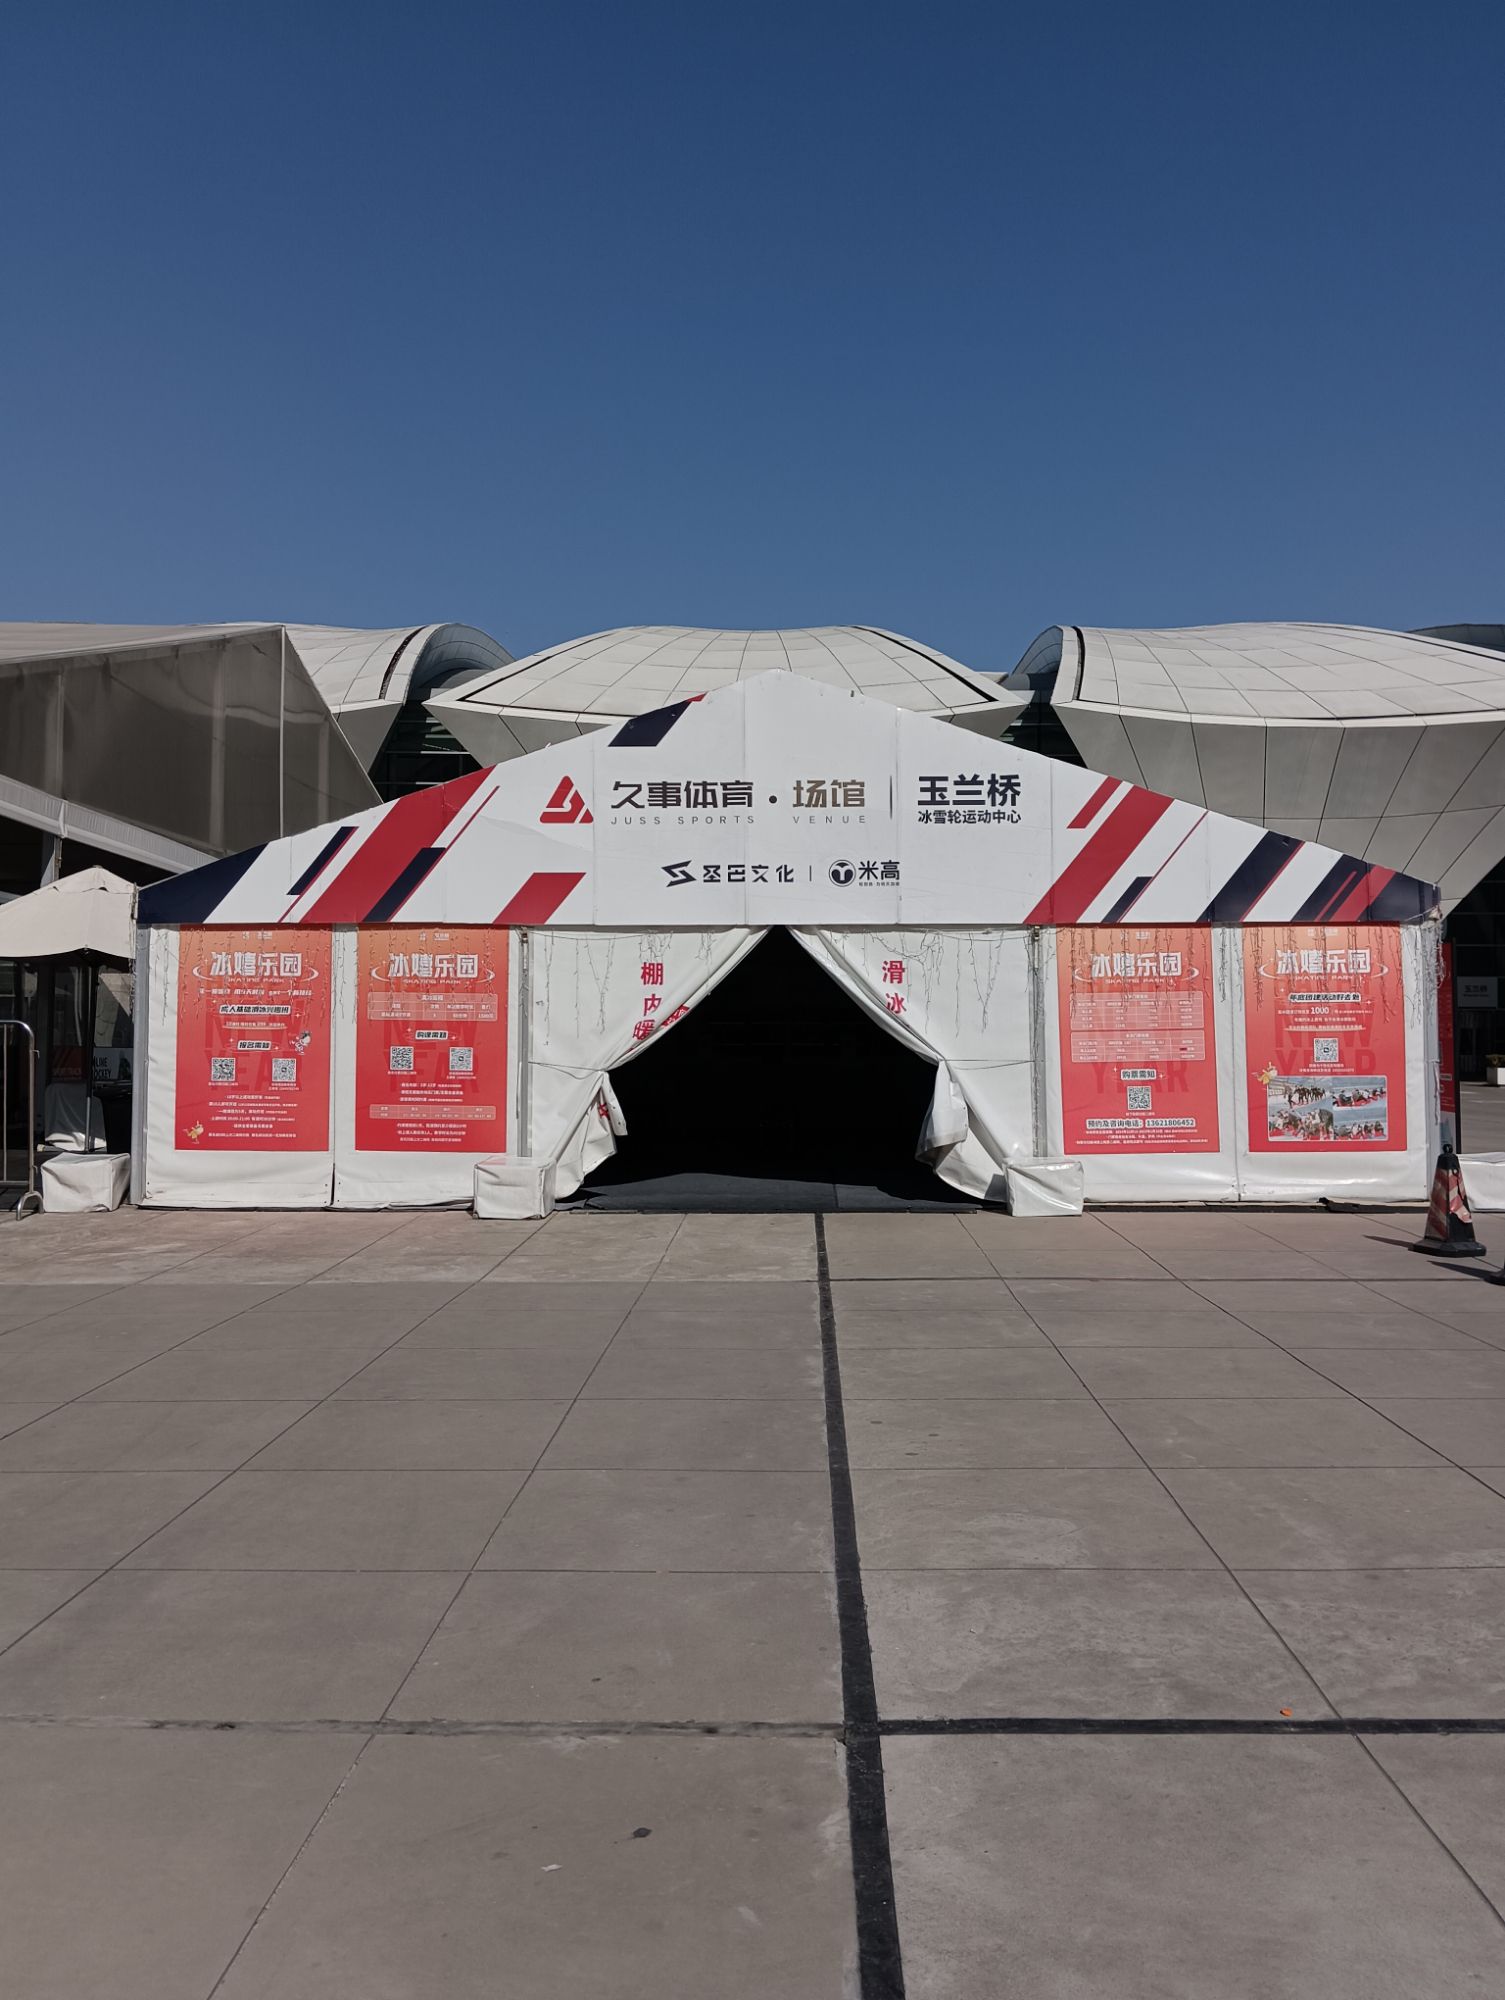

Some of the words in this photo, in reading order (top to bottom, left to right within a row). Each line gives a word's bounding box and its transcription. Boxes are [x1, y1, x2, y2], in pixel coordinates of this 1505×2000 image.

[917, 773, 1022, 807] 玉兰桥
[611, 816, 661, 825] JUSS
[677, 815, 755, 825] SPORTS
[792, 815, 866, 825] VENUE
[917, 809, 1022, 825] 冰雪轮运动中心
[858, 859, 900, 881] 米高
[210, 952, 302, 977] 冰嬉乐园
[387, 953, 479, 978] 冰嬉乐园
[1090, 952, 1182, 977] 冰嬉乐园
[1275, 948, 1371, 975] 冰嬉乐园
[881, 960, 906, 1015] 滑冰
[1310, 1007, 1330, 1015] 1000
[1122, 1069, 1156, 1079] 购票需知
